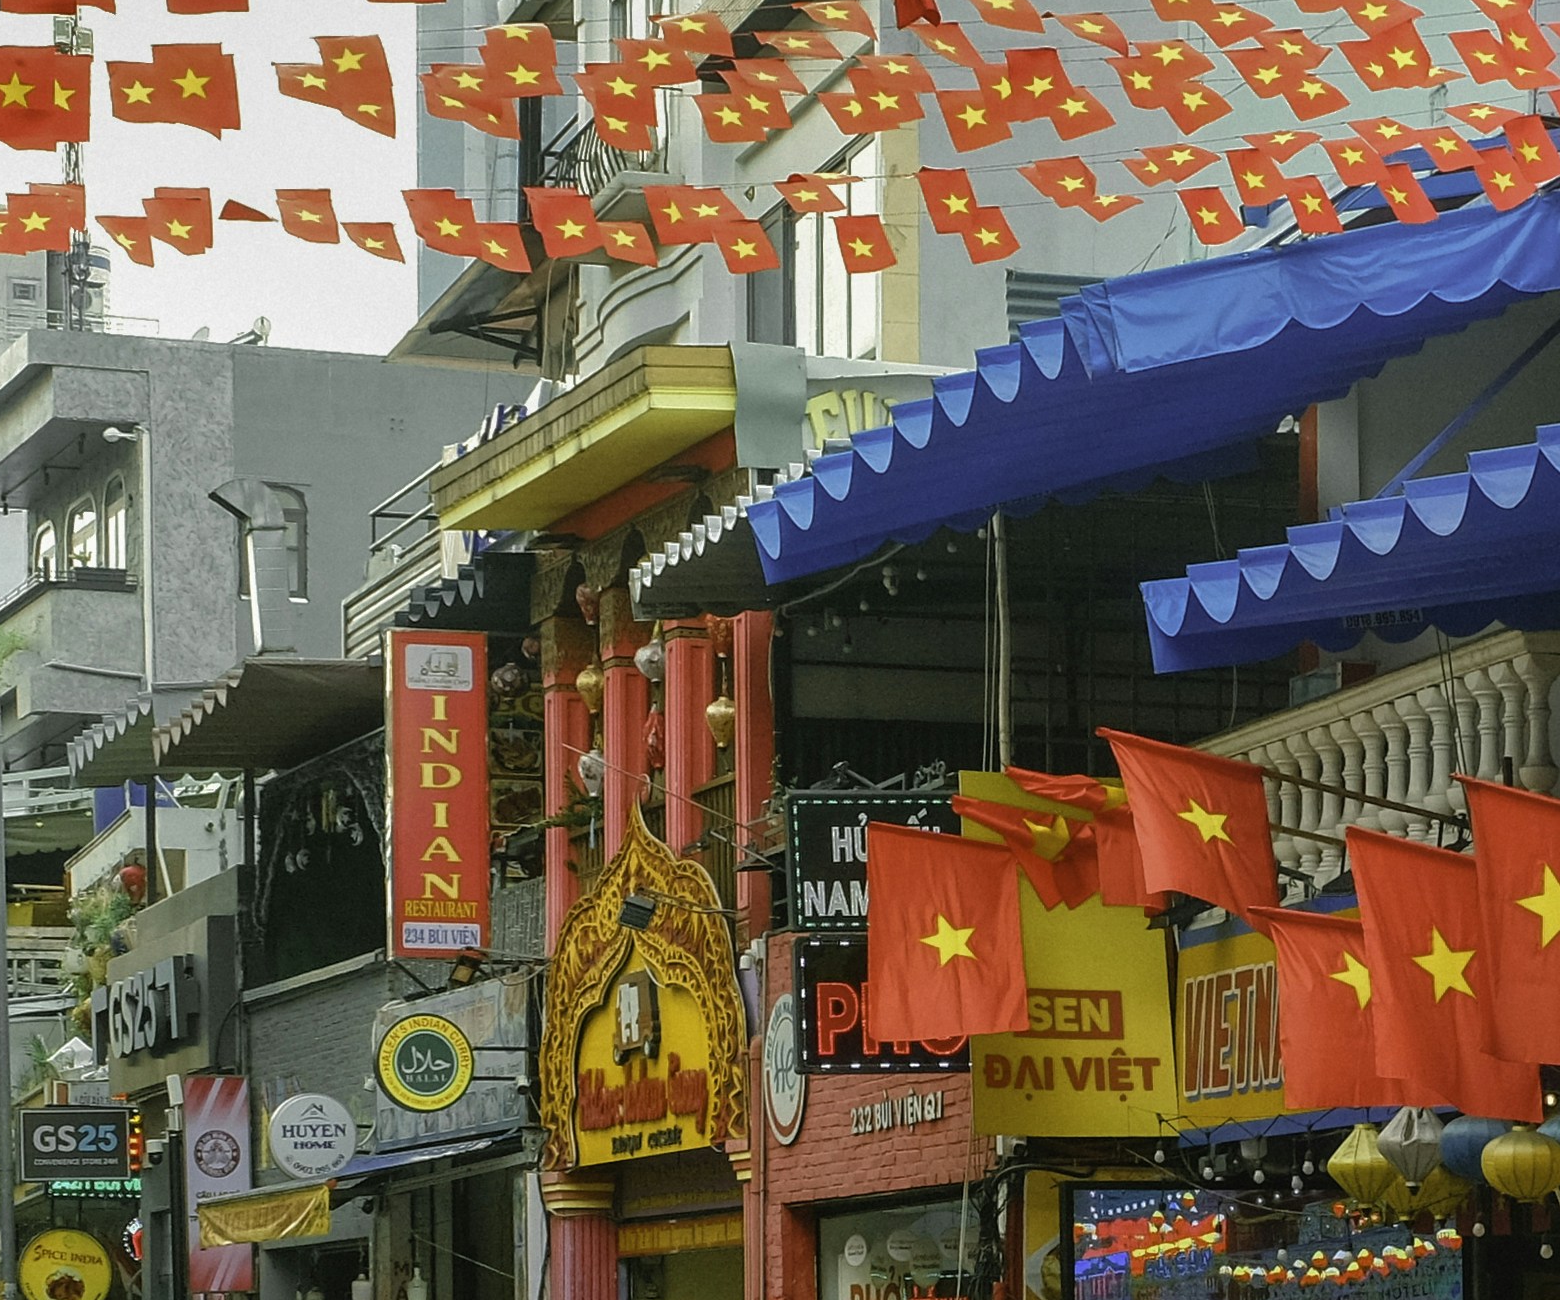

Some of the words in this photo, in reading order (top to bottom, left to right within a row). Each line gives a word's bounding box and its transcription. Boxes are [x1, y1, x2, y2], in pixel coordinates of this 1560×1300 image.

[419, 694, 463, 900] INDIAN
[404, 899, 478, 919] RESTAURANT
[404, 927, 425, 945] 234
[1028, 995, 1111, 1033] SEN
[409, 1017, 449, 1033] INDIAN
[448, 1027, 471, 1070] CURRY
[405, 1074, 448, 1083] HALAL
[983, 1054, 1055, 1102] ĐẠI
[1061, 1047, 1161, 1102] VIỆT
[281, 1123, 347, 1139] HUYEN
[850, 1103, 873, 1135] 232
[32, 1124, 119, 1153] GS25
[293, 1140, 336, 1150] HOME
[34, 1245, 68, 1261] SPICE
[70, 1252, 104, 1266] INDIA
